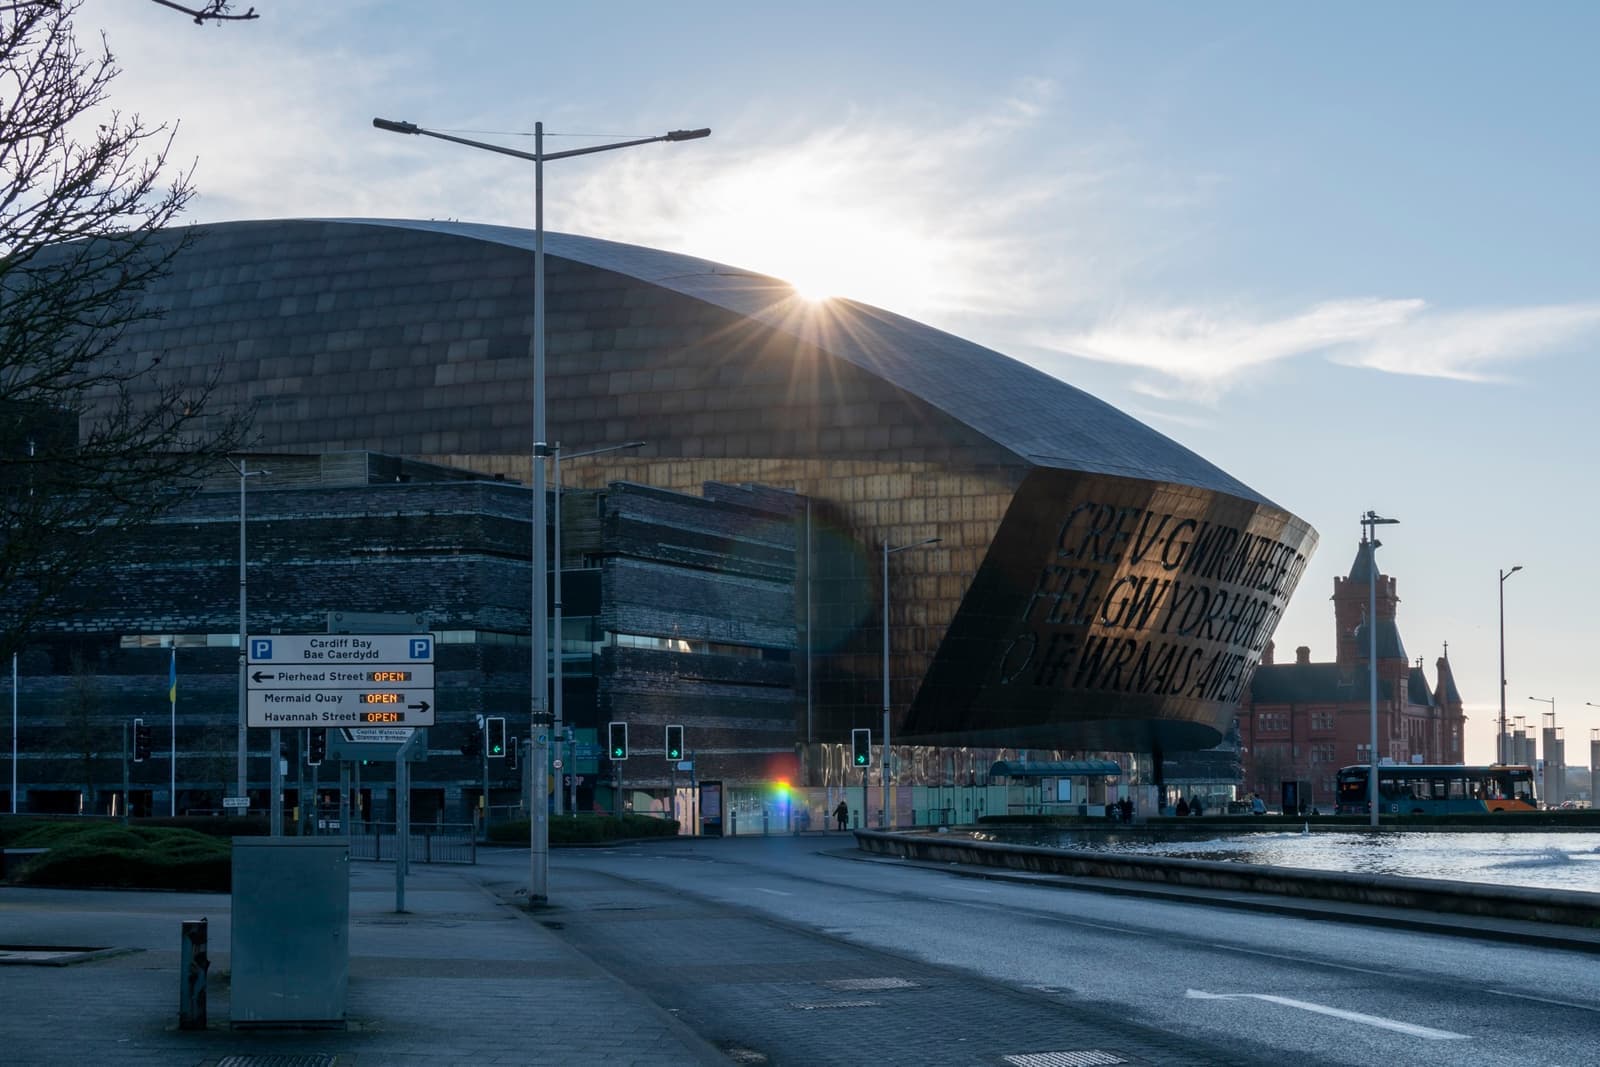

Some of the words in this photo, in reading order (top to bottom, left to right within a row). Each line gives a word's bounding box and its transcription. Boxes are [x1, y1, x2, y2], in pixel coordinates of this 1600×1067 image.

[256, 641, 270, 657] P
[310, 639, 349, 649] Cardiff
[352, 639, 372, 650] Bay
[414, 641, 427, 657] P
[303, 650, 324, 659] Bae
[327, 650, 379, 661] Caerdydd
[278, 672, 326, 681] Pierhead
[329, 672, 364, 681] Street
[374, 672, 405, 682] OPEN
[264, 694, 311, 703] Mermaid
[315, 694, 343, 705] Quay
[367, 694, 398, 704] OPEN
[264, 713, 318, 722] Havannah
[322, 713, 357, 722] Street
[367, 713, 398, 723] OPEN
[564, 775, 584, 786] SOP
